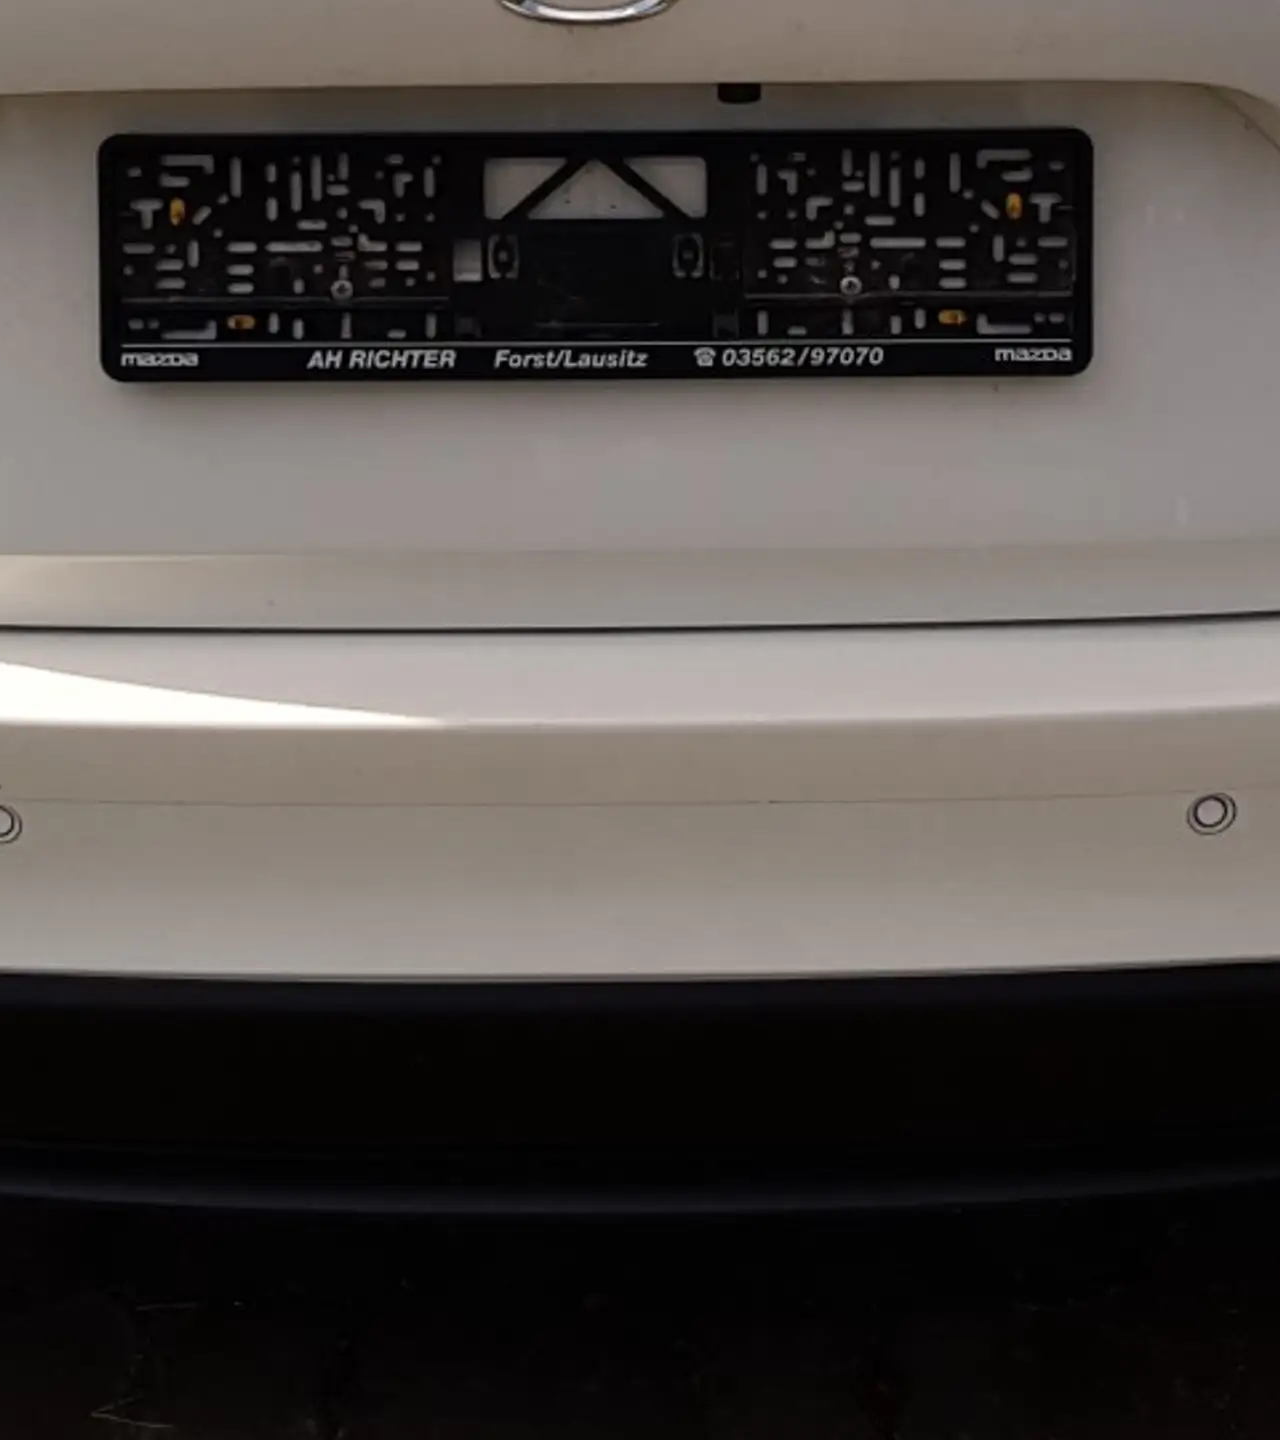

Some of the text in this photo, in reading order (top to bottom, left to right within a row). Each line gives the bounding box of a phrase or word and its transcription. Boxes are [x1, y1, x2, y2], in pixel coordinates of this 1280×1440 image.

[307, 347, 884, 370] AH RICHTER Forst/Lausitz 03562/97070
